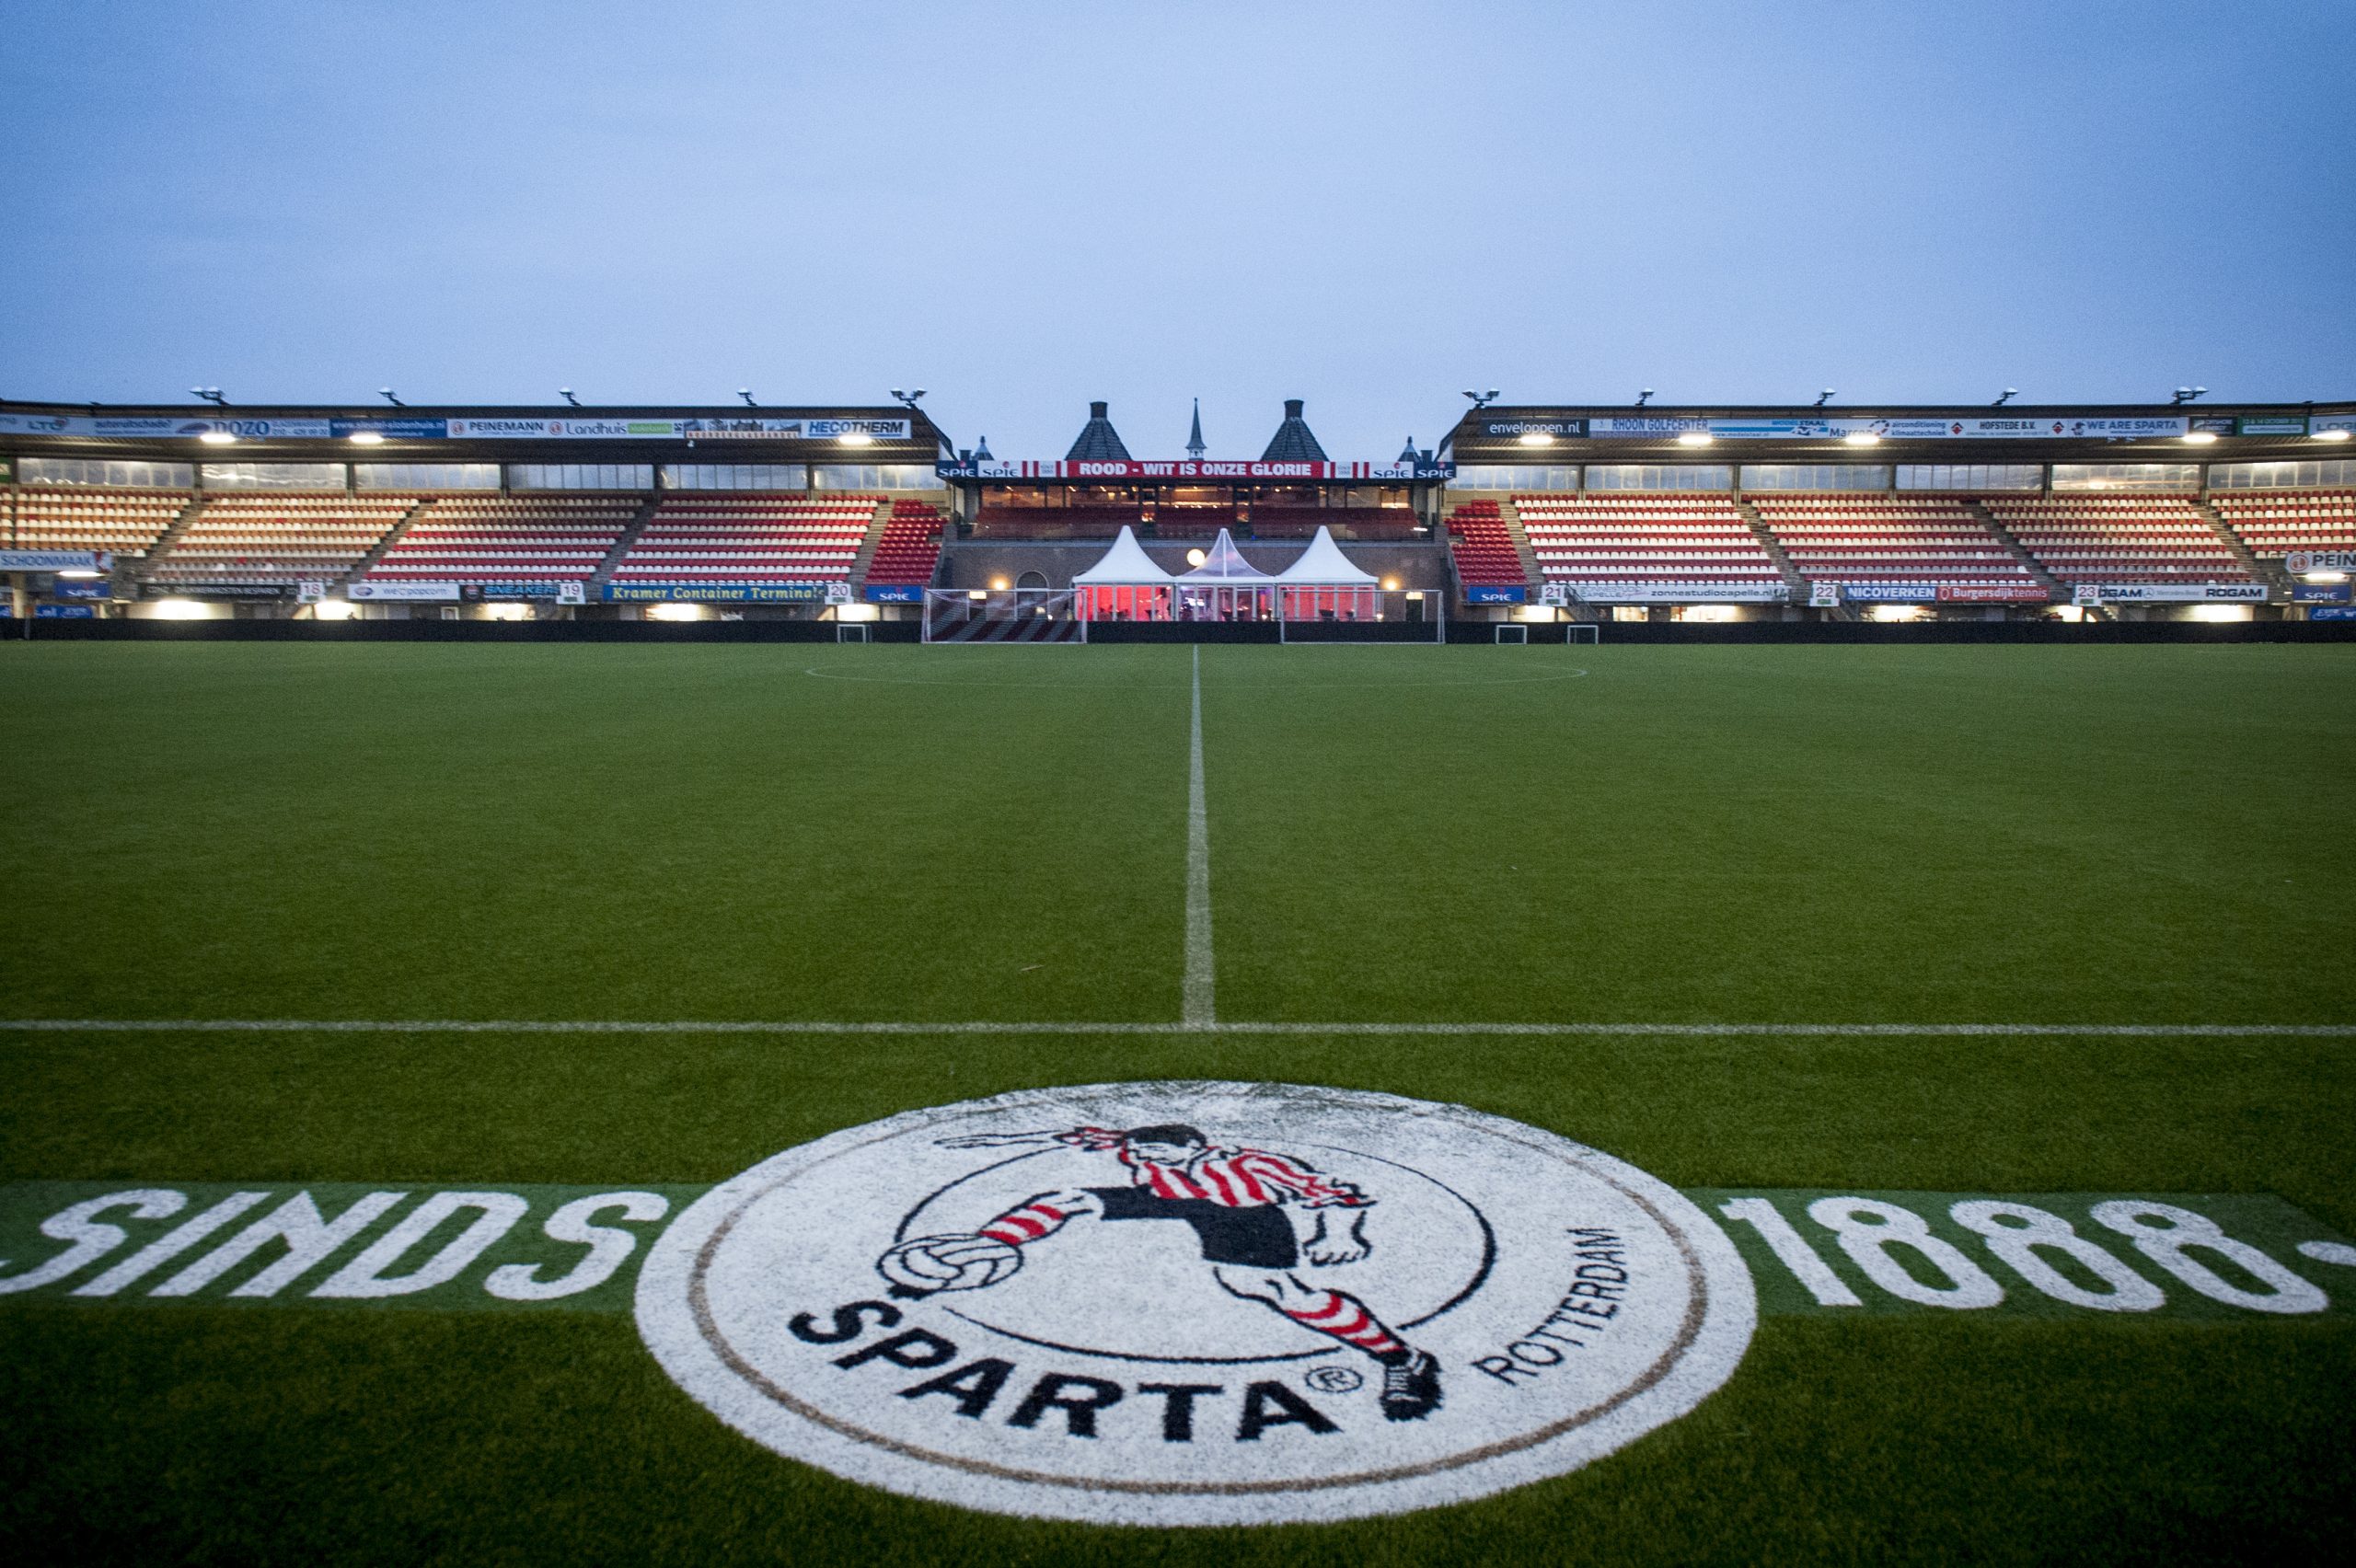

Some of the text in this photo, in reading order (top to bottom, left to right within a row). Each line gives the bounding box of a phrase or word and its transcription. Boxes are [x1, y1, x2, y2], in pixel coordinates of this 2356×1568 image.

[469, 421, 544, 432] PEINEMANN
[566, 422, 627, 435] Landhuis
[809, 421, 904, 433] HECOTHERM
[1489, 421, 1580, 436] enveloppen.nl
[1612, 419, 1708, 431] RHOON GOLFCENTER
[1891, 421, 1946, 429] airconditioning
[1980, 421, 2036, 430] HOFSTEDE B.V.
[2087, 421, 2178, 430] WE ARE SPARTA
[939, 467, 976, 478] SPIE
[983, 467, 1018, 478] SPIE
[1080, 463, 1127, 475] ROOD
[1143, 463, 1175, 475] WIT
[1179, 464, 1196, 475] IS
[1201, 464, 1246, 476] ONZE
[1251, 464, 1311, 476] GLORIE
[1373, 469, 1410, 478] SPIE
[1417, 469, 1454, 478] SPIE
[304, 584, 320, 594] 18
[564, 584, 581, 595] 19
[612, 586, 825, 599] Kramer Container Terminals
[831, 586, 848, 596] 20
[1545, 587, 1562, 597] 21
[1651, 588, 1773, 598] zonnestudiocapelle.nl
[1816, 587, 1833, 597] 22
[1848, 587, 1935, 598] NICOVERKEN
[1953, 587, 2048, 600] Burgersdijktennis
[2078, 587, 2096, 597] 23
[2206, 588, 2262, 597] ROGAM
[879, 593, 910, 601] SPIE
[2304, 592, 2338, 600] SPIE
[0, 1188, 670, 1300] SINDS
[1717, 1196, 2329, 1315] 1888
[1470, 1228, 1629, 1387] ROTTERDAM
[787, 1298, 1346, 1444] SPARTA
